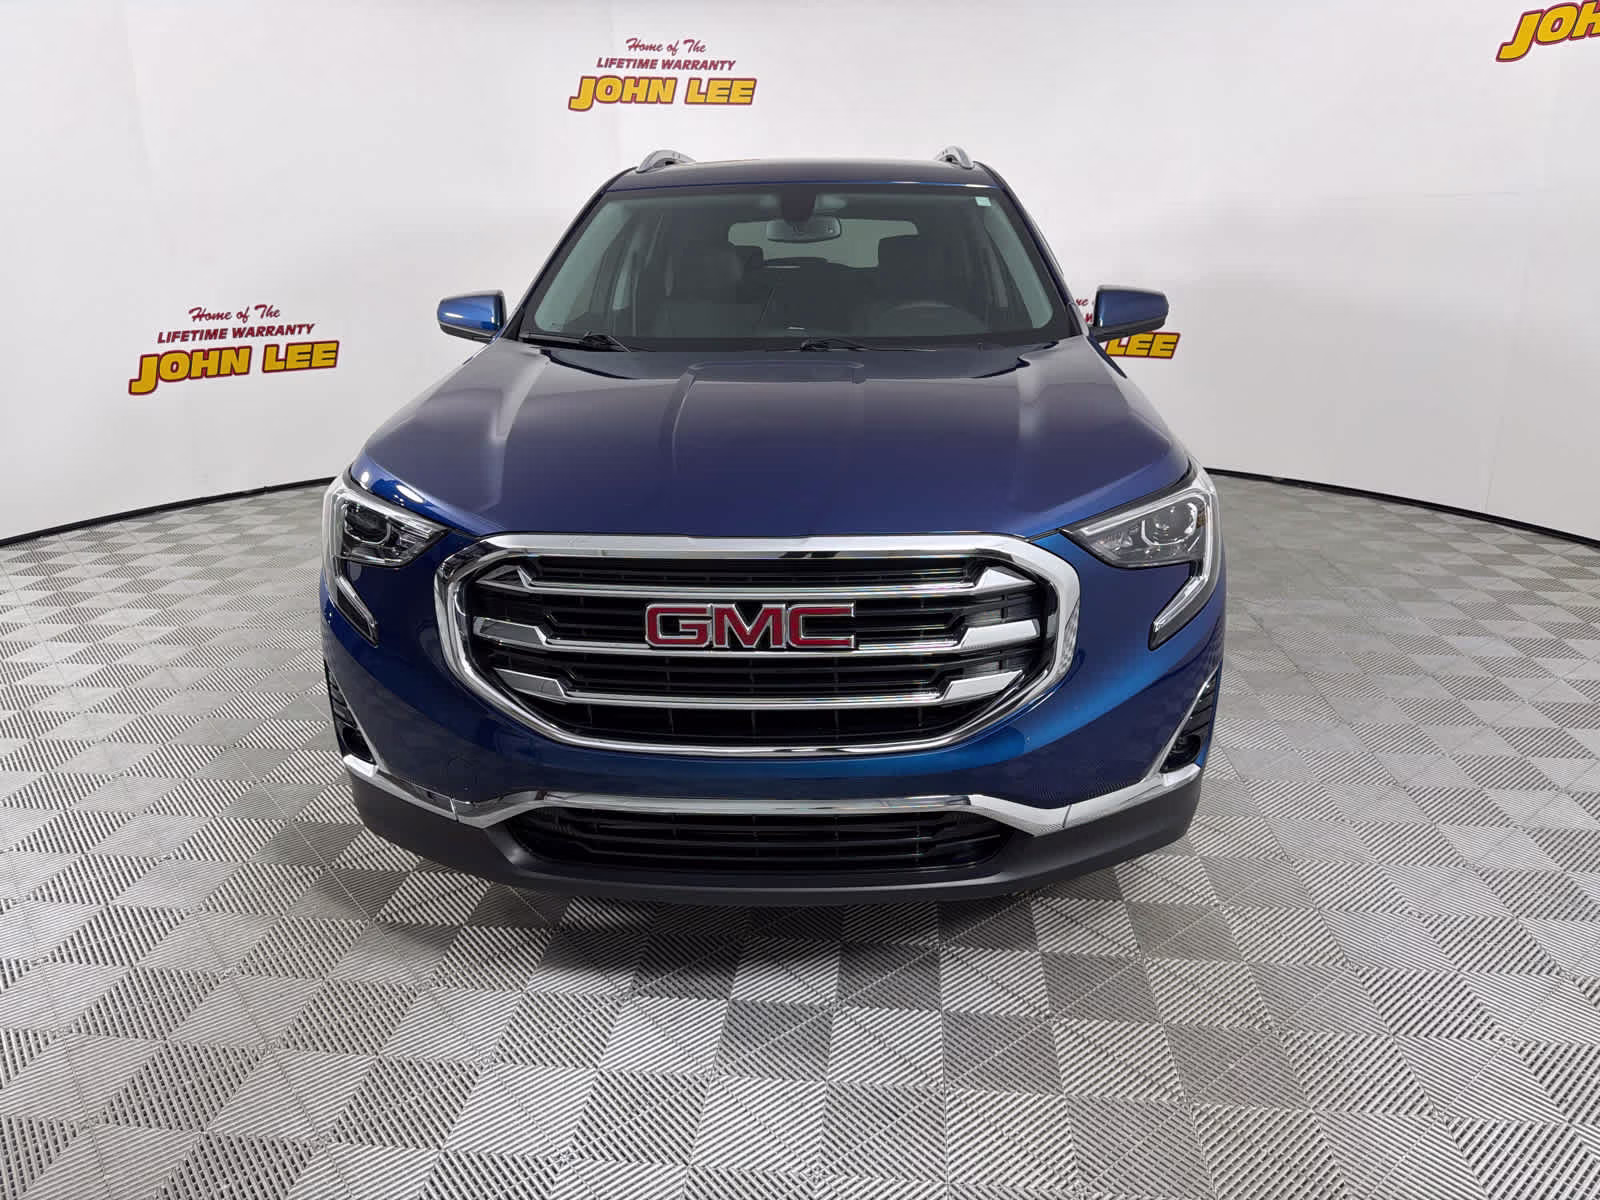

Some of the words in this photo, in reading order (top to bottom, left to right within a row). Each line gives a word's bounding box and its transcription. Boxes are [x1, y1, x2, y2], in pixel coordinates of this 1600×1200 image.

[625, 37, 664, 52] Home
[666, 40, 680, 56] of
[683, 38, 707, 53] The
[596, 57, 658, 69] LIFETIME
[661, 59, 736, 71] WARRANTY
[568, 75, 678, 111] JOHN
[684, 78, 757, 105] LEE
[188, 306, 232, 322] Home
[236, 306, 250, 323] of
[254, 304, 280, 319] The
[157, 327, 228, 344] LIFETIME
[232, 323, 316, 339] WARRANTY
[128, 346, 252, 395] JOHN
[262, 340, 339, 373] LEE
[645, 603, 855, 649] GMC
